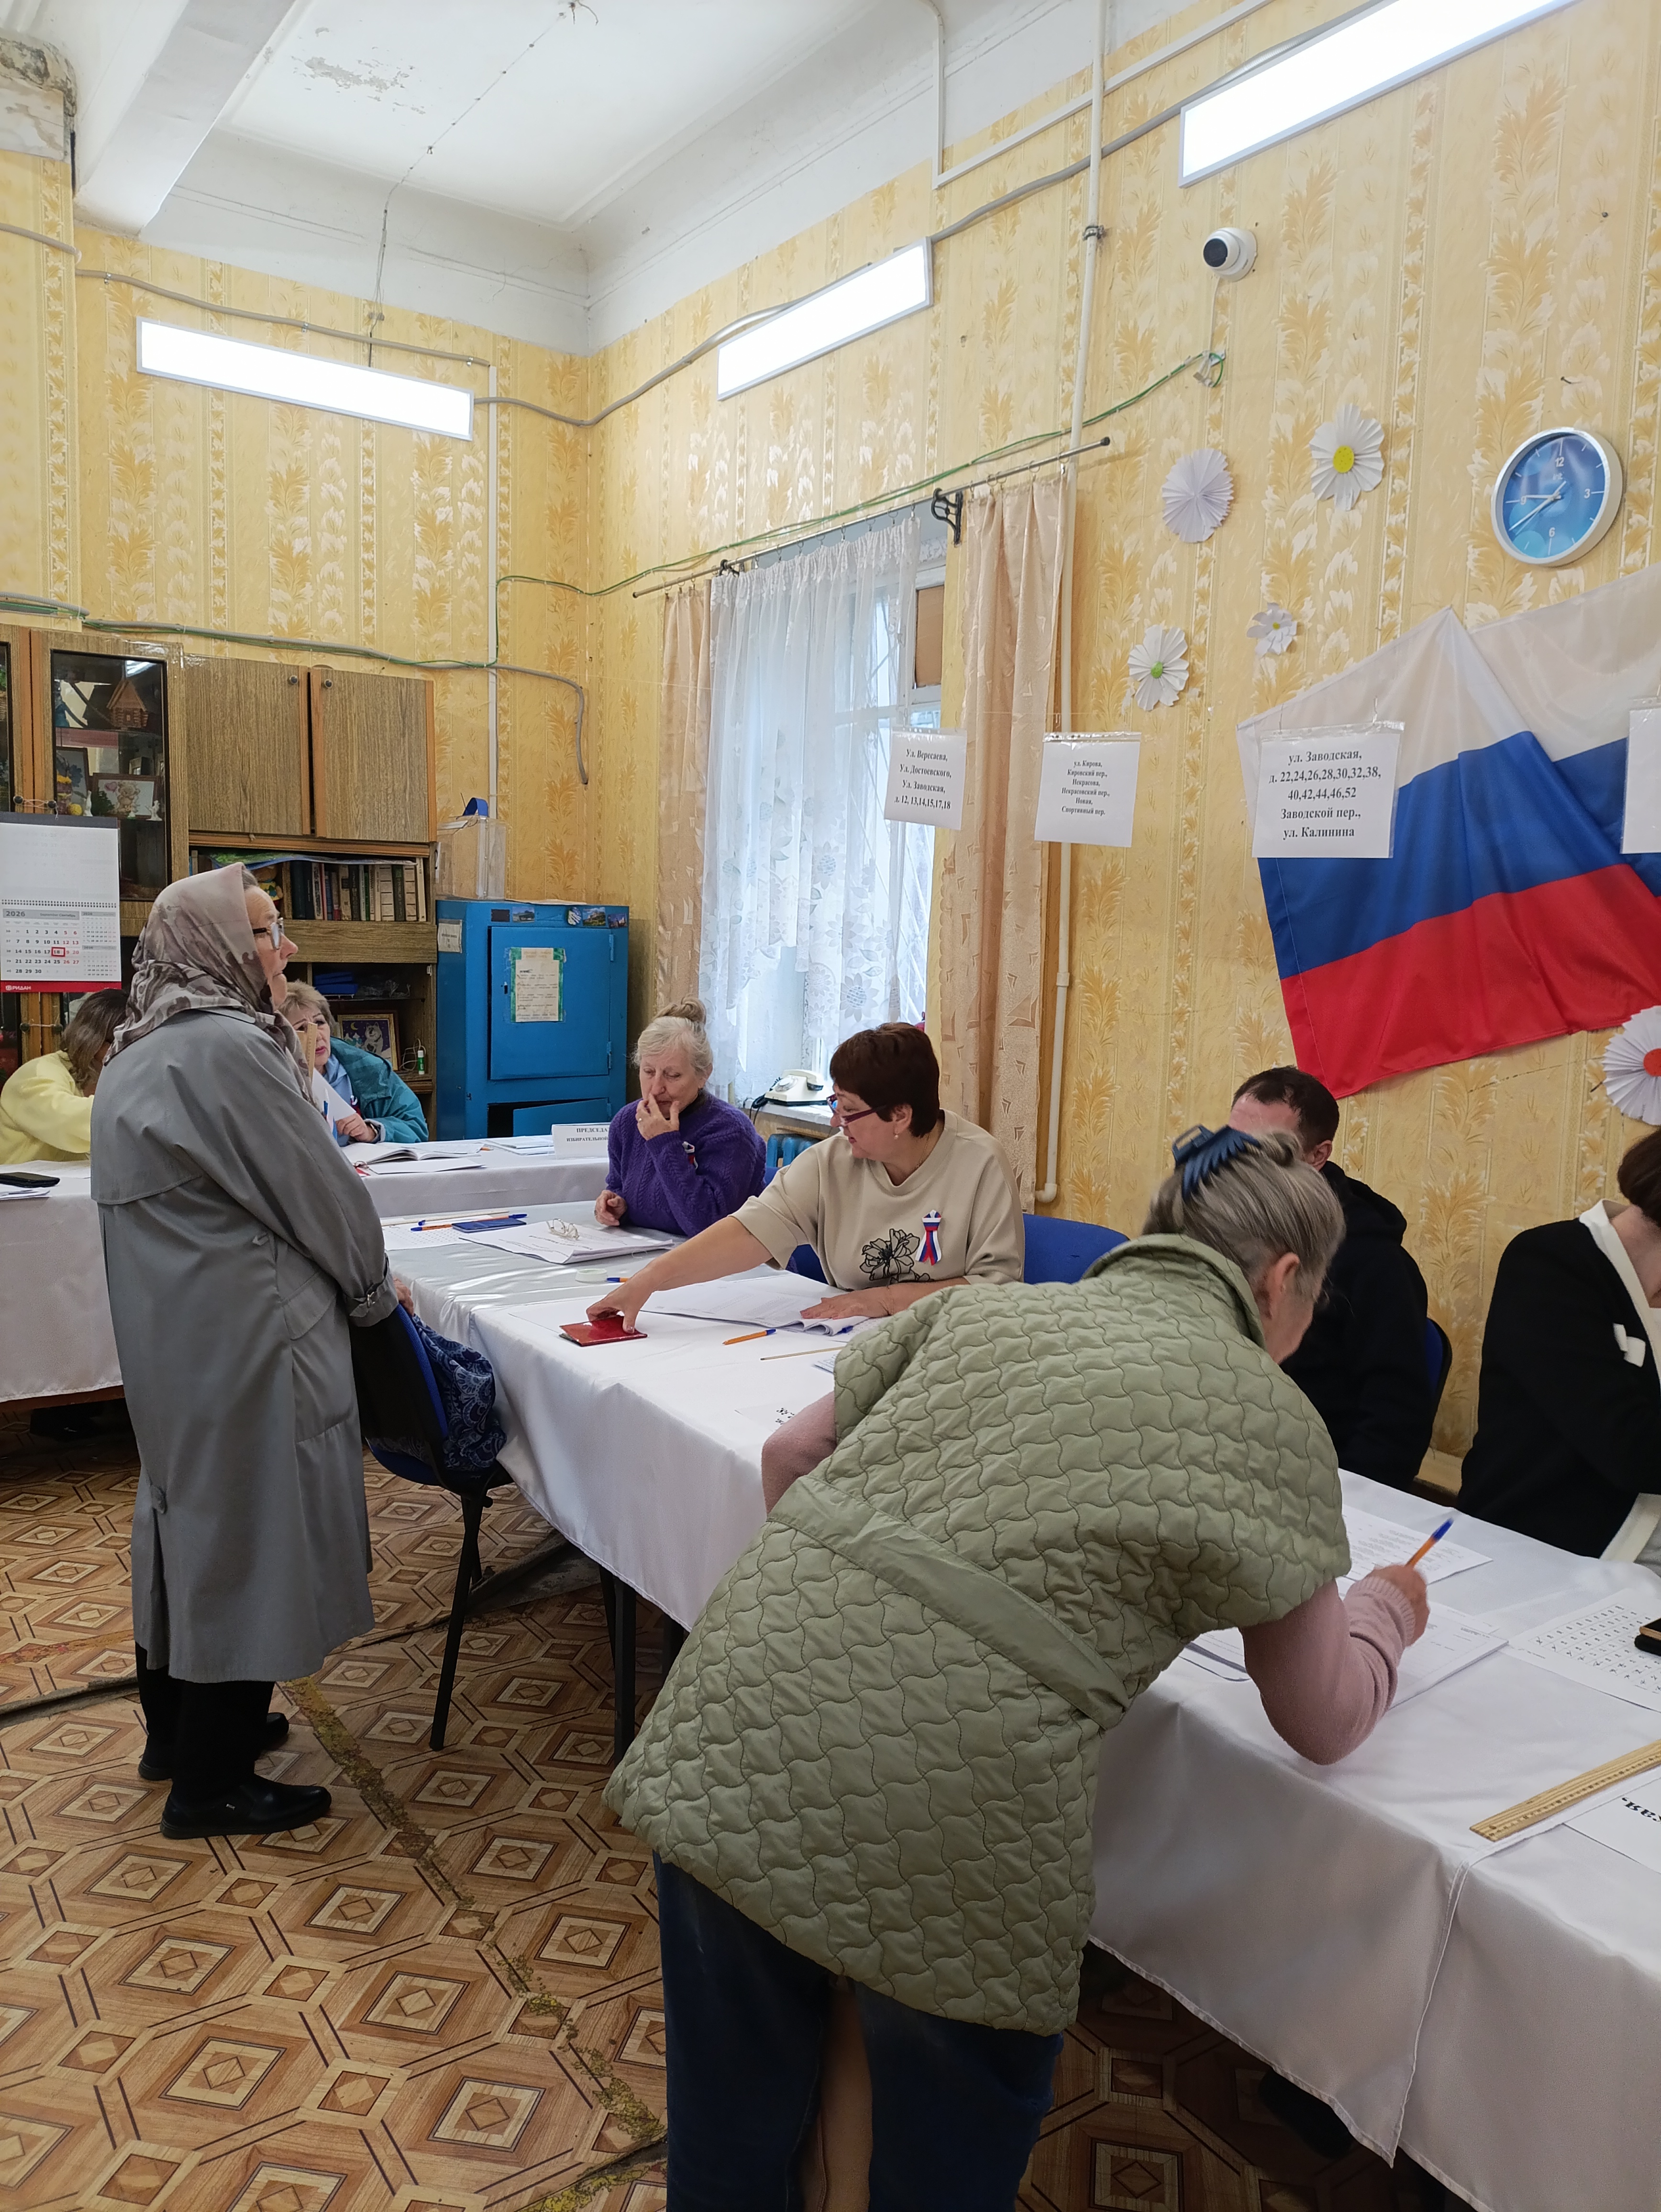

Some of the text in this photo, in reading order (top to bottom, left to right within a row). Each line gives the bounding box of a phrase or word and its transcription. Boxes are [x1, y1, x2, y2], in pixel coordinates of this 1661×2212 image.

[1555, 457, 1564, 467] 12
[1584, 488, 1590, 498] 3
[1549, 528, 1555, 537] 6
[907, 749, 948, 762] Ул. Вересаева,
[1288, 751, 1362, 765] ул. Заводская,
[1082, 760, 1102, 768] Кирова,
[900, 764, 952, 779] Ул. Достоевского,
[1067, 769, 1095, 777] Кировский
[1269, 766, 1381, 784] д. 22,24,26,28,30,32,38,
[903, 780, 945, 794] Ул. Заводская,
[1073, 779, 1100, 787] Некрасова,
[1062, 787, 1096, 796] Некрасовский
[1288, 787, 1356, 801] 40,42,44,46,52
[911, 796, 951, 810] 13,14,15,17,18
[1062, 806, 1094, 815] Спортивный
[1281, 807, 1361, 820] Заводской пер.,
[1283, 827, 1354, 840] ул. Калинина
